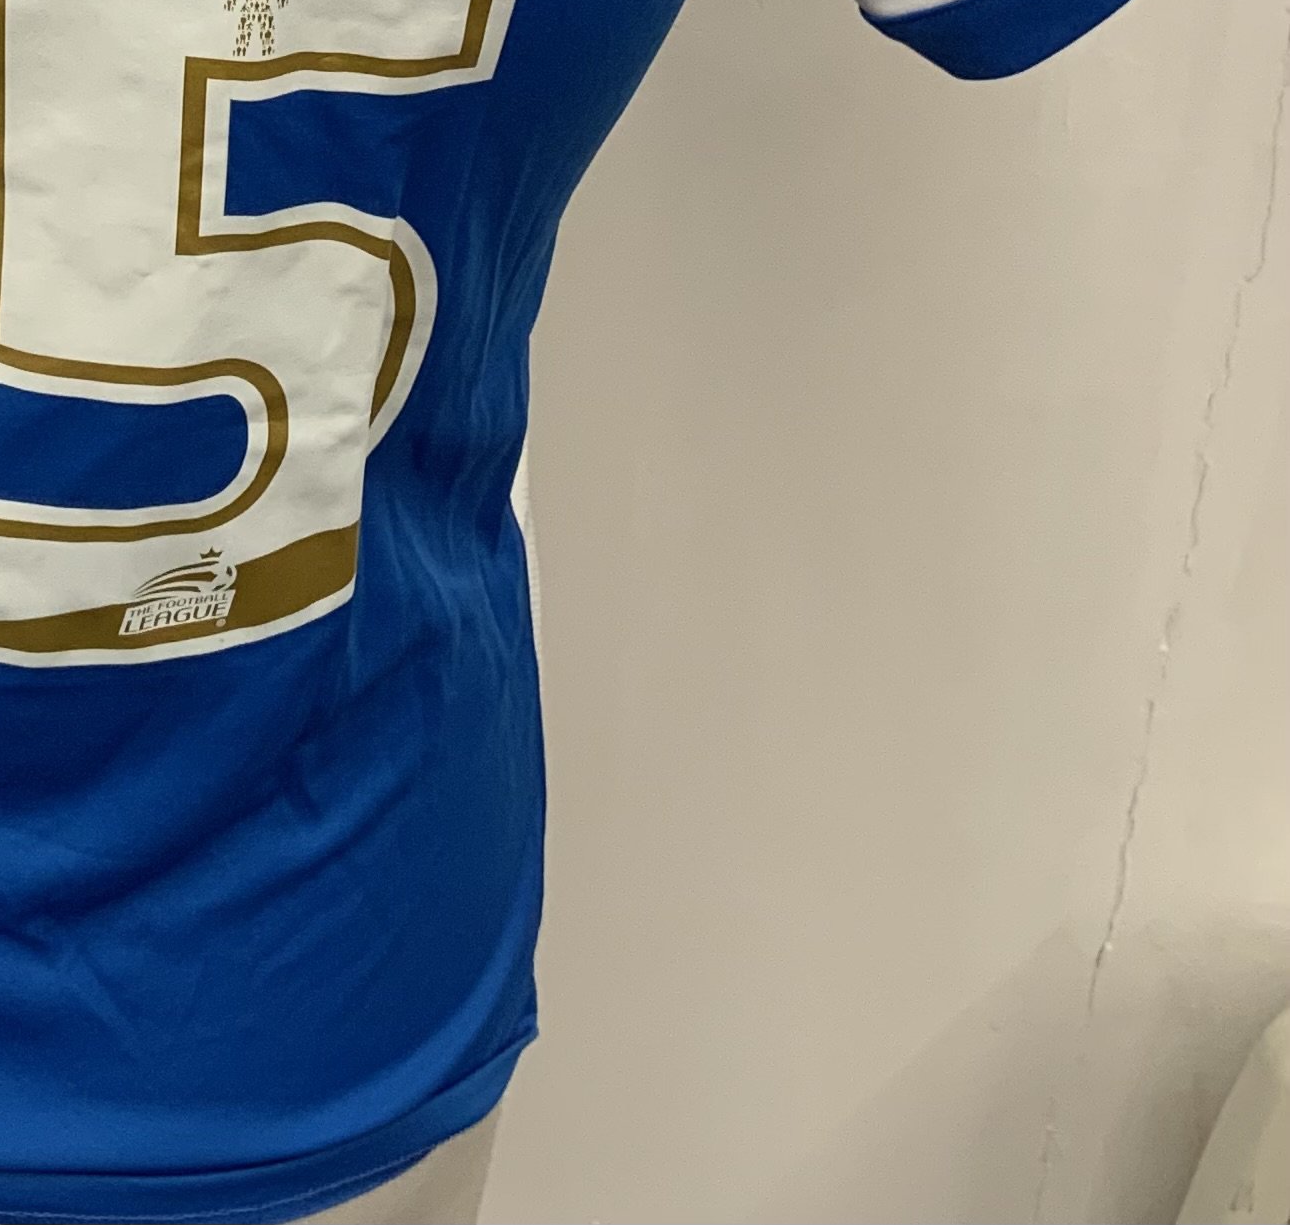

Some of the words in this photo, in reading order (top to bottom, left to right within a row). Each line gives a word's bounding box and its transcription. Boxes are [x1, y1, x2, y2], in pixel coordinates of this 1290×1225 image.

[124, 601, 228, 633] LEAGUE
[131, 604, 154, 618] THE
[158, 593, 228, 611] FOOTBALL
